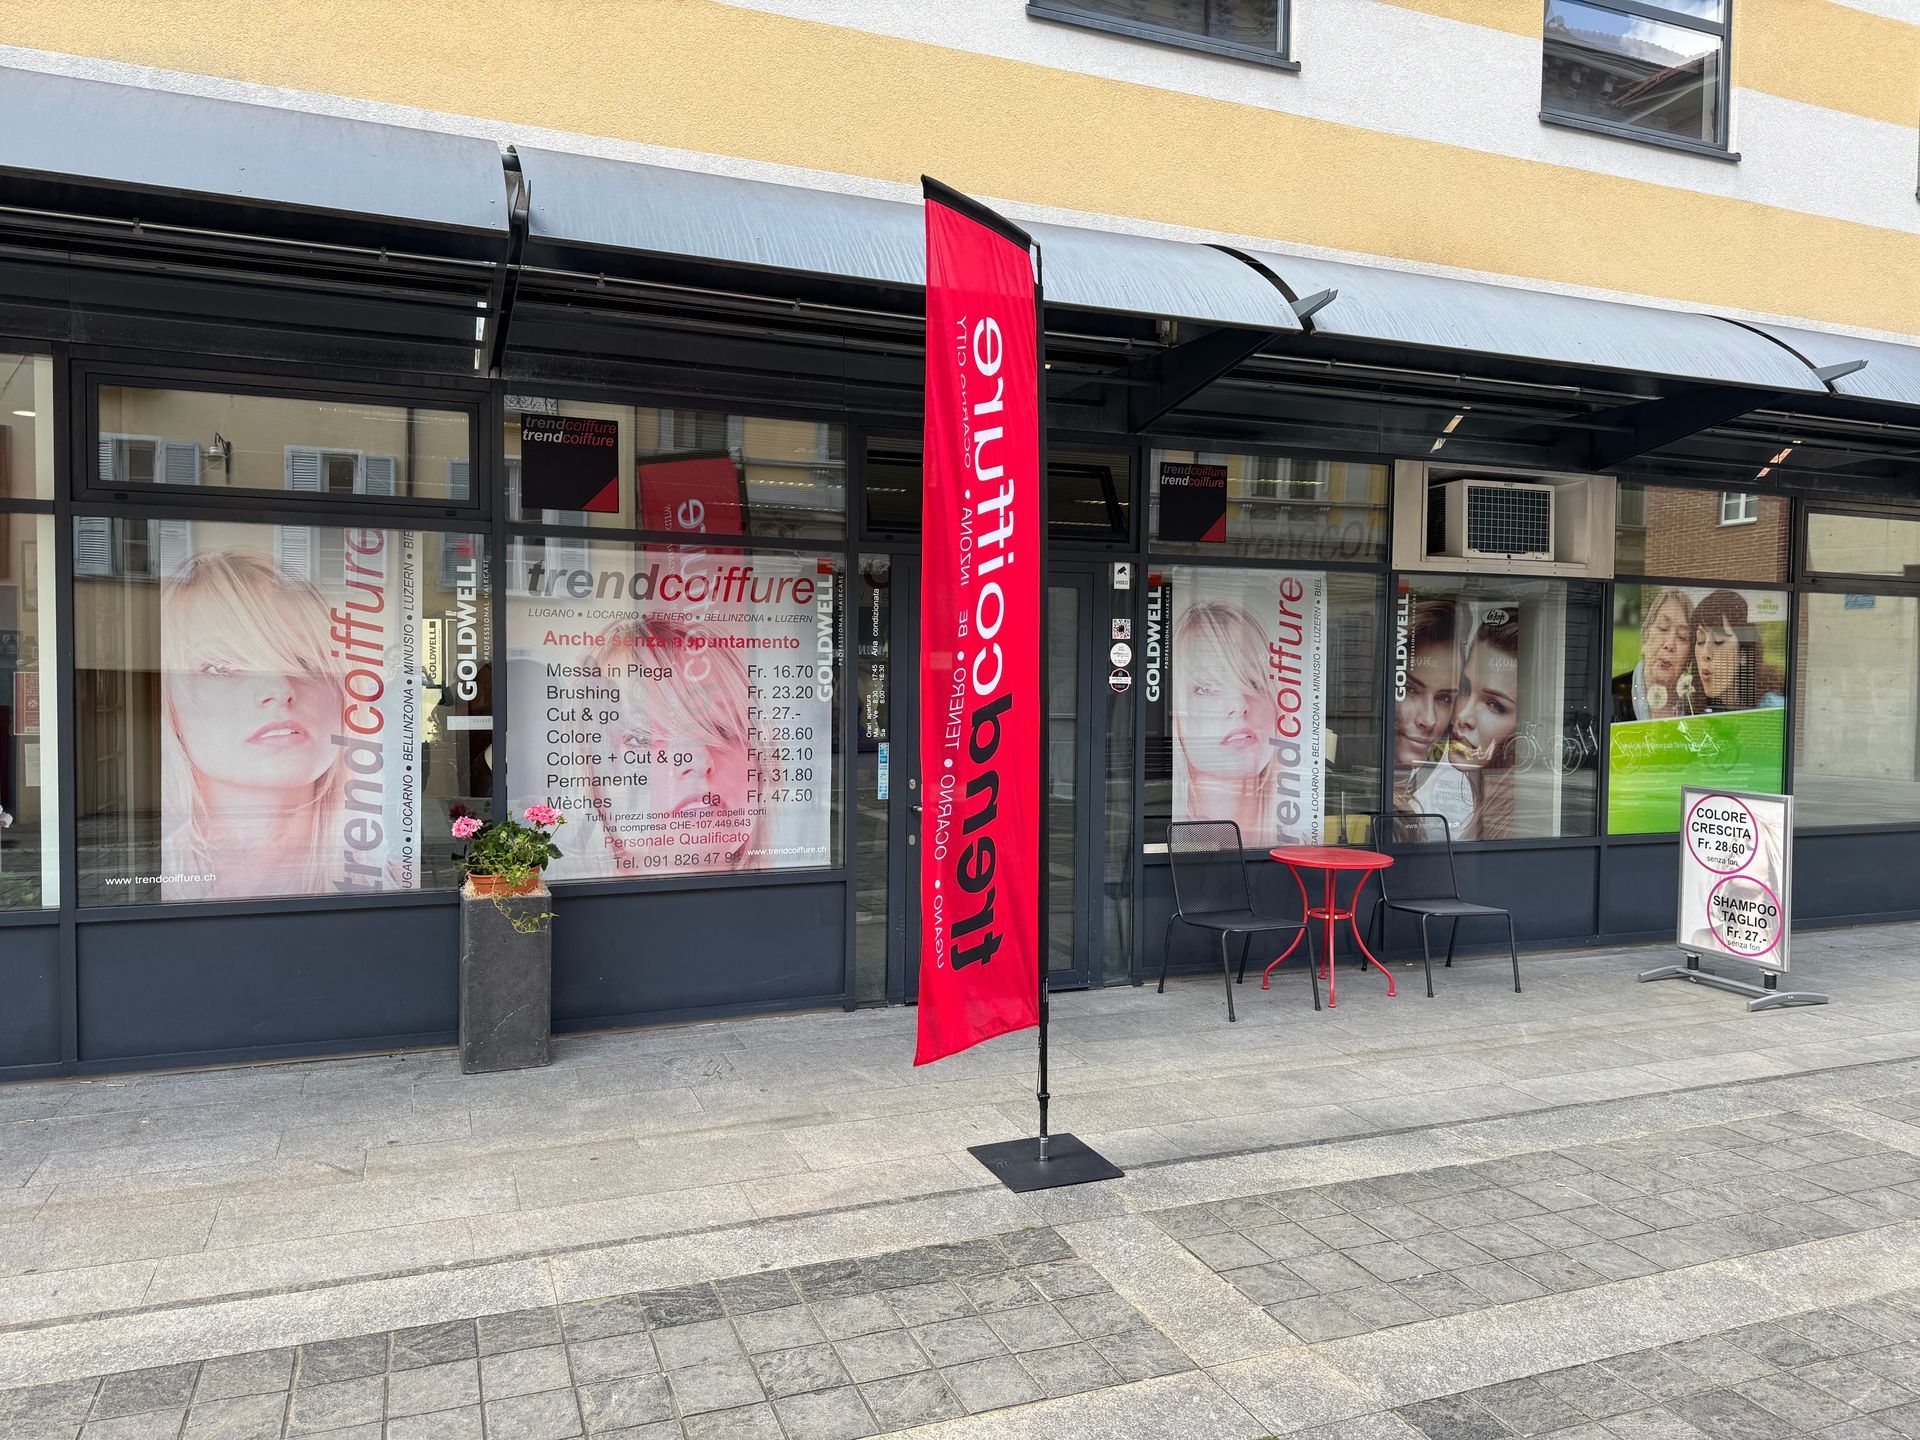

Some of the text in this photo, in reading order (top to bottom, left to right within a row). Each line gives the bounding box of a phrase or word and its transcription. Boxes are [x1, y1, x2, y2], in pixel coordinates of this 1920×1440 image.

[525, 416, 617, 434] trendcoiffure
[522, 429, 614, 447] trendcoiffure
[1163, 463, 1227, 478] trendcoiffure
[1160, 474, 1225, 488] trendcoiffure
[403, 562, 415, 611] LUZERN
[528, 560, 815, 605] trendcoiffure
[1314, 576, 1322, 597] BIEL
[528, 608, 813, 623] LUGANO LOCARNO TENERO BELLINZONA LUZERN
[871, 588, 880, 657] Aria condizionata
[1313, 606, 1322, 644] LUZERN
[456, 558, 478, 701] GOLDWELL
[543, 630, 605, 647] Anche
[612, 634, 666, 648] senza
[816, 574, 834, 703] GOLDWELL
[403, 623, 415, 676] MINUSIO
[1145, 585, 1162, 702] GOLDWELL
[1394, 593, 1410, 702] GOLDWELL
[428, 632, 437, 680] GOLDWELL
[546, 663, 814, 681] Messa in Piega Fr. 16.70
[1312, 652, 1321, 693] MINUSIO
[546, 686, 814, 702] Brushing Fr. 23.20
[402, 688, 414, 762] BELLINZONA
[546, 706, 801, 725] Cut & go Fr. 27.-
[546, 727, 813, 744] Colore Fr. 28.60
[1311, 701, 1320, 758] BELLINZONA
[546, 751, 602, 766] Colore
[623, 750, 652, 765] Cut
[656, 749, 668, 764] &
[673, 752, 694, 767] go
[747, 748, 767, 762] Fr.
[771, 748, 813, 761] 42.10
[546, 768, 813, 789] Permanente Fr. 31.80
[546, 788, 813, 810] Mèches da Fr. 47.50
[1311, 767, 1320, 812] LOCARNO
[402, 776, 414, 833] LOCARNO
[585, 812, 607, 822] Tutti
[614, 811, 644, 823] prezzi
[646, 811, 670, 820] sono
[672, 809, 698, 819] intesi
[699, 809, 714, 819] per
[716, 807, 745, 818] capelli
[747, 807, 767, 816] corti
[1696, 807, 1747, 824] COLORE
[602, 818, 751, 833] Iva compresa CHE-107.449.643
[1691, 821, 1751, 840] CRESCITA
[604, 832, 750, 849] Personale Qualificato
[1697, 837, 1745, 855] Fr. 28.60
[747, 846, 827, 856] www.trendcoiffure.ch
[1706, 855, 1726, 864] senza
[613, 857, 639, 870] Tel.
[643, 855, 669, 868] 091
[674, 853, 700, 866] 826
[703, 852, 720, 864] 47
[1713, 895, 1777, 917] SHAMPOO
[1721, 910, 1768, 929] TAGLIO
[1726, 926, 1767, 944] Fr. 27.-
[1727, 940, 1761, 952] senza fon
